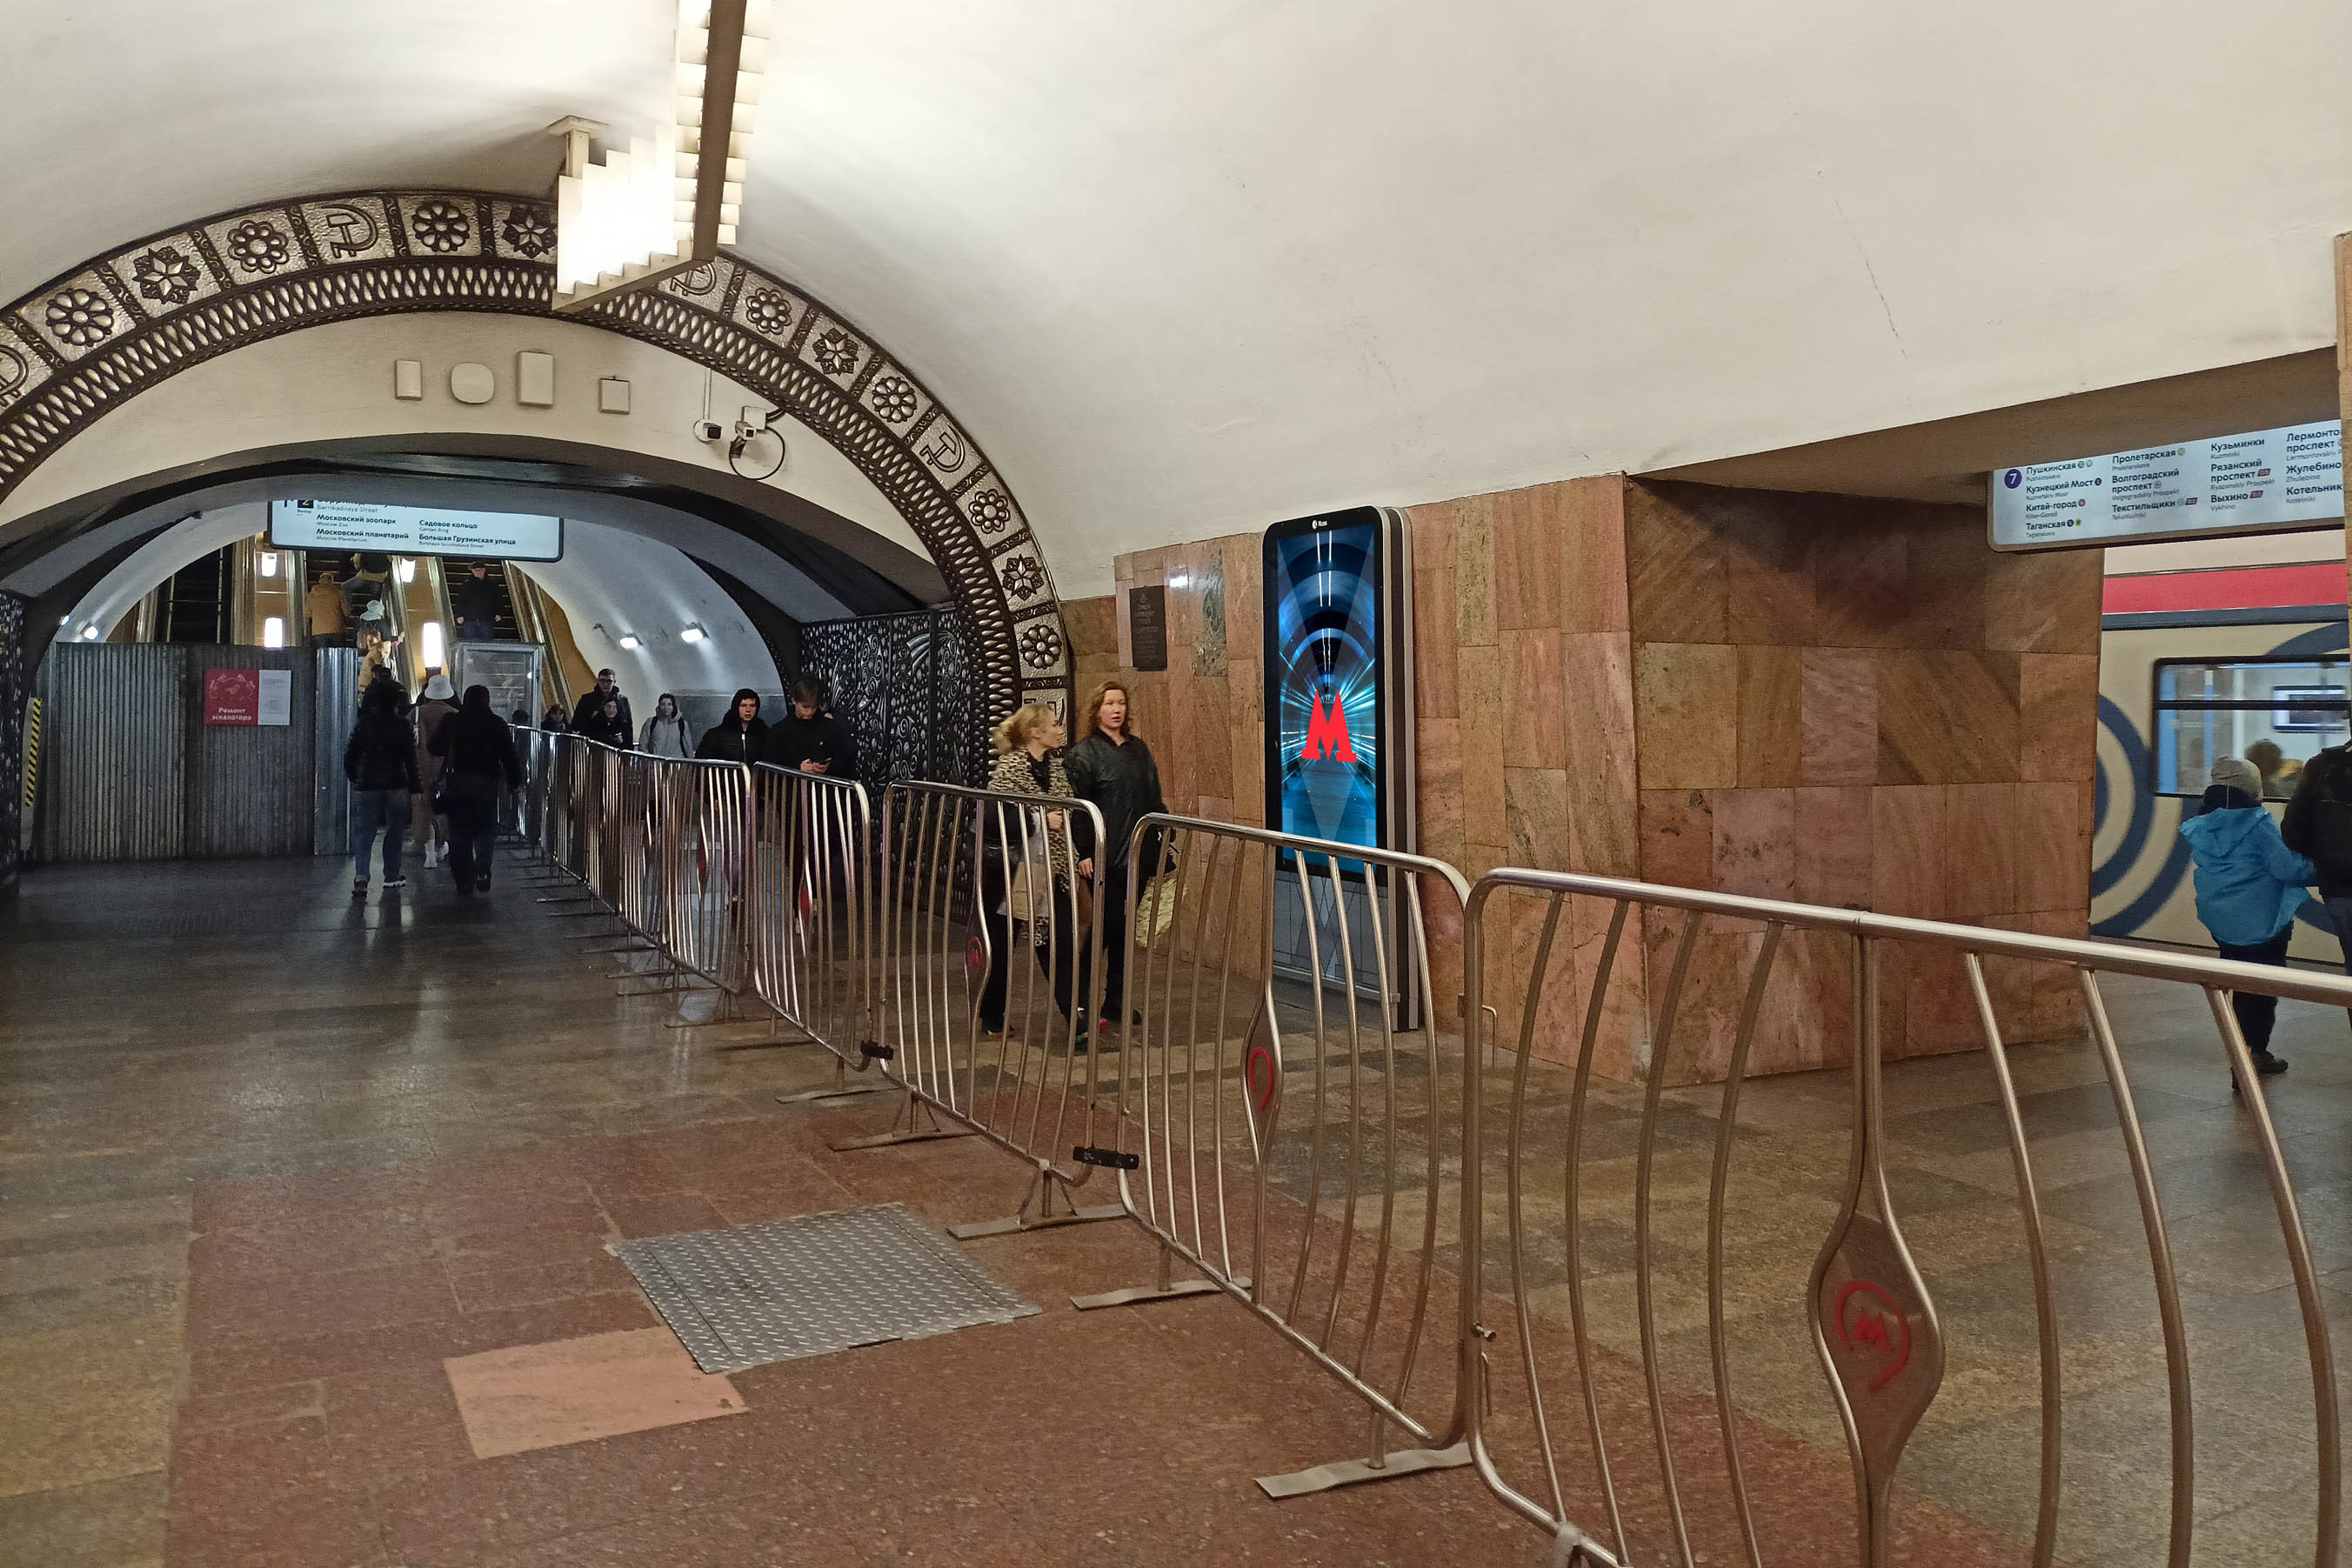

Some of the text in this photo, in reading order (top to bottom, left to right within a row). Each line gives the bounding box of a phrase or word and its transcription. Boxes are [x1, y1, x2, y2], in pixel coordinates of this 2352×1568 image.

[2211, 439, 2265, 452] Кузьминки
[2286, 441, 2335, 453] проспект
[2112, 450, 2176, 464] Пролетарская
[2026, 463, 2076, 476] Пушкинская
[2211, 458, 2262, 471] Рязанский
[2286, 462, 2342, 475] Жулебино
[2009, 472, 2018, 484] 7
[2112, 469, 2180, 484] Волгоградский
[2211, 471, 2255, 483] проспект
[2026, 482, 2069, 494] Кузнецкий
[2112, 483, 2153, 493] проспект
[2211, 493, 2248, 503] Выхино
[2026, 501, 2077, 511] Китай-город
[2112, 500, 2176, 512] Текстильщики
[317, 514, 364, 523] Московский
[2026, 521, 2066, 530] Таганская
[316, 528, 364, 537] Московский
[453, 535, 494, 544] Грузинская
